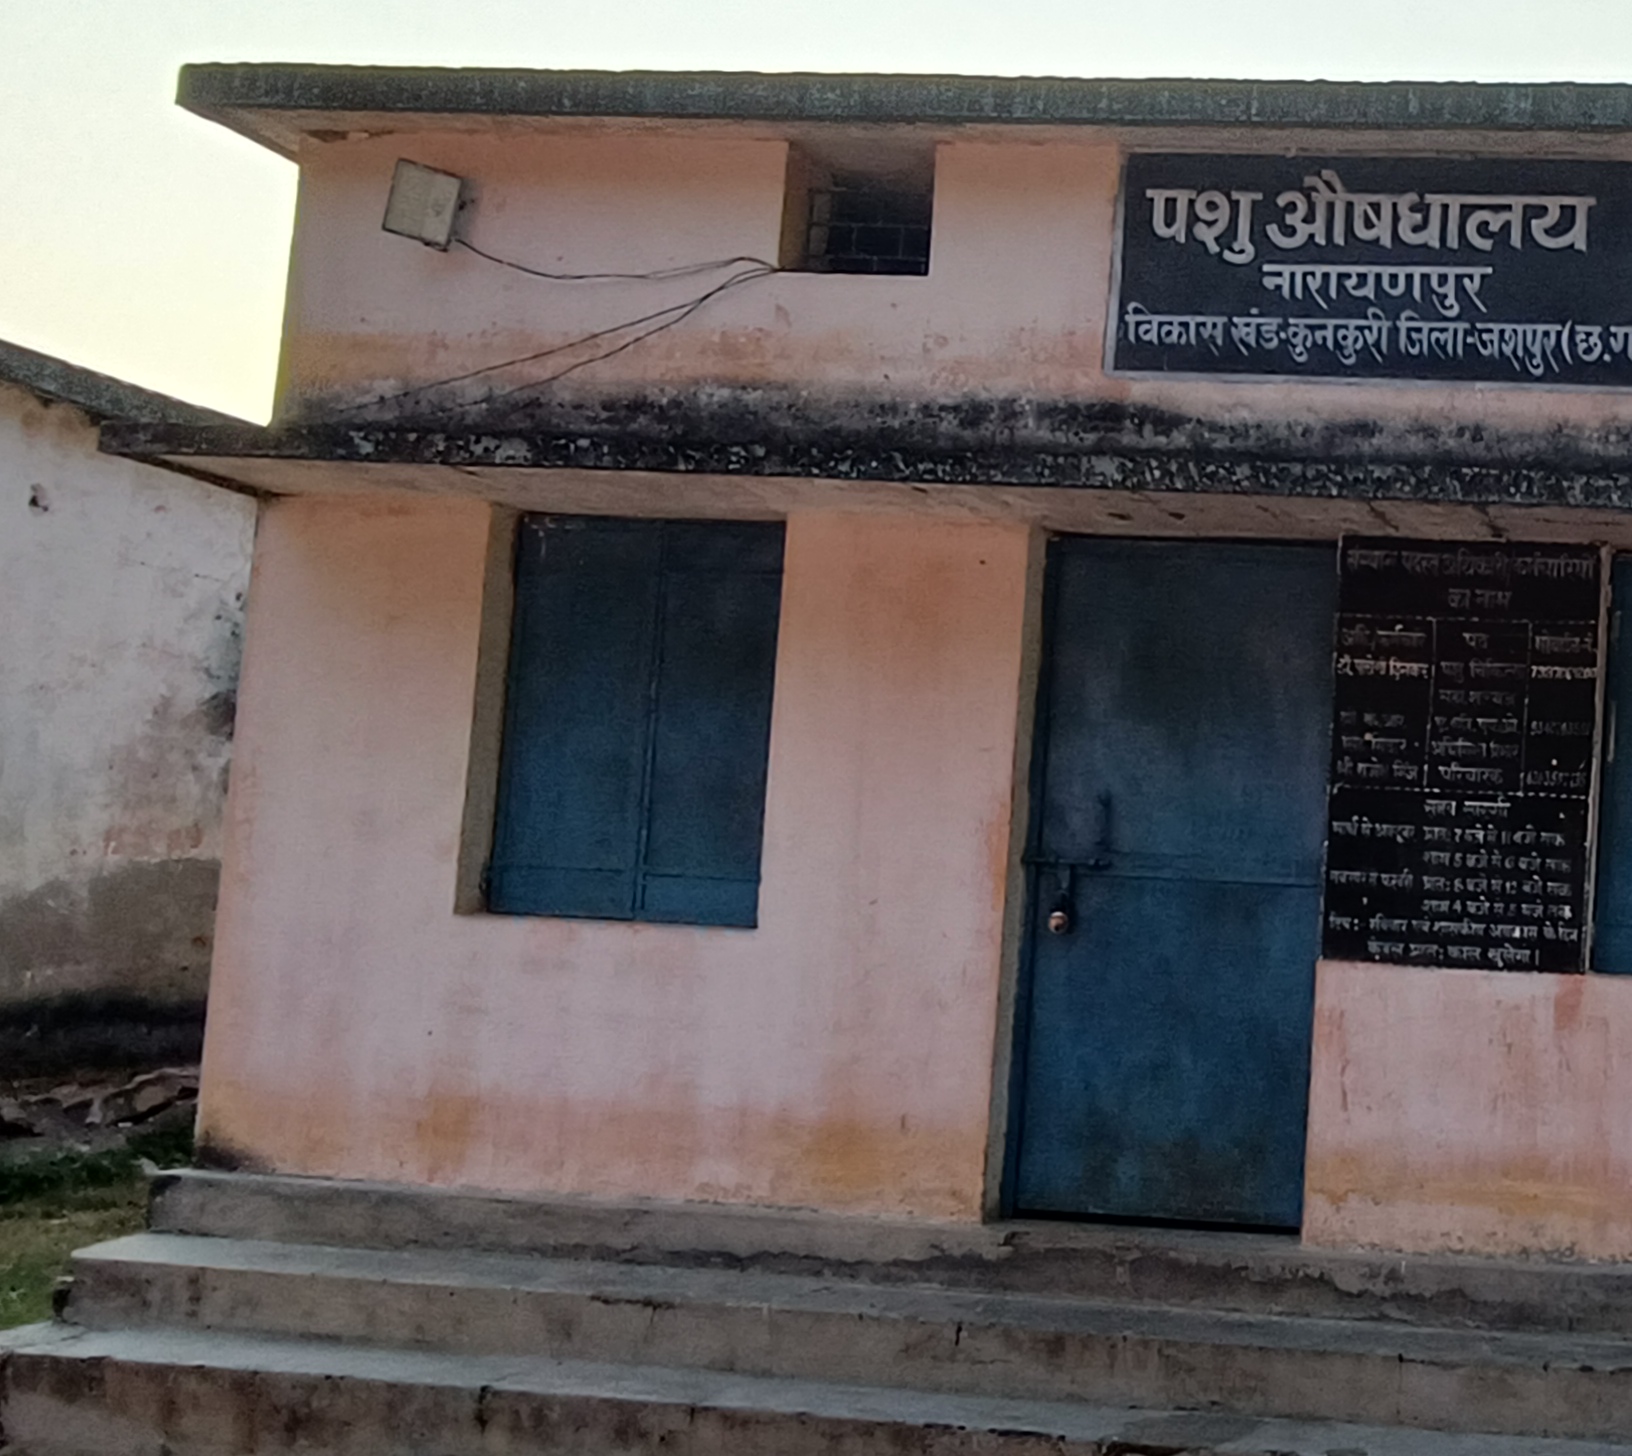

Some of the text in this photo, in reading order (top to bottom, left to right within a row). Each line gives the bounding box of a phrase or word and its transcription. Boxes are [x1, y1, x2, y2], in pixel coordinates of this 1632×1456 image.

[1146, 170, 1597, 264] पशु औषधालय
[1262, 263, 1493, 316] नारायणपुर
[1124, 302, 1224, 354] विकास
[1448, 588, 1513, 610] का नाम
[1453, 828, 1461, 843] 7
[1464, 823, 1485, 844] बजे
[1513, 823, 1537, 846] बजे
[1453, 853, 1462, 868] 5
[1465, 848, 1488, 868] बजे
[1504, 854, 1515, 869] 6
[1518, 851, 1542, 871] बजे
[1465, 872, 1488, 893] बजे
[1522, 874, 1543, 896] बजे
[1452, 899, 1462, 914] 4
[1465, 895, 1490, 916] बजे
[1521, 898, 1543, 919] बजे
[1446, 944, 1482, 961] काल
